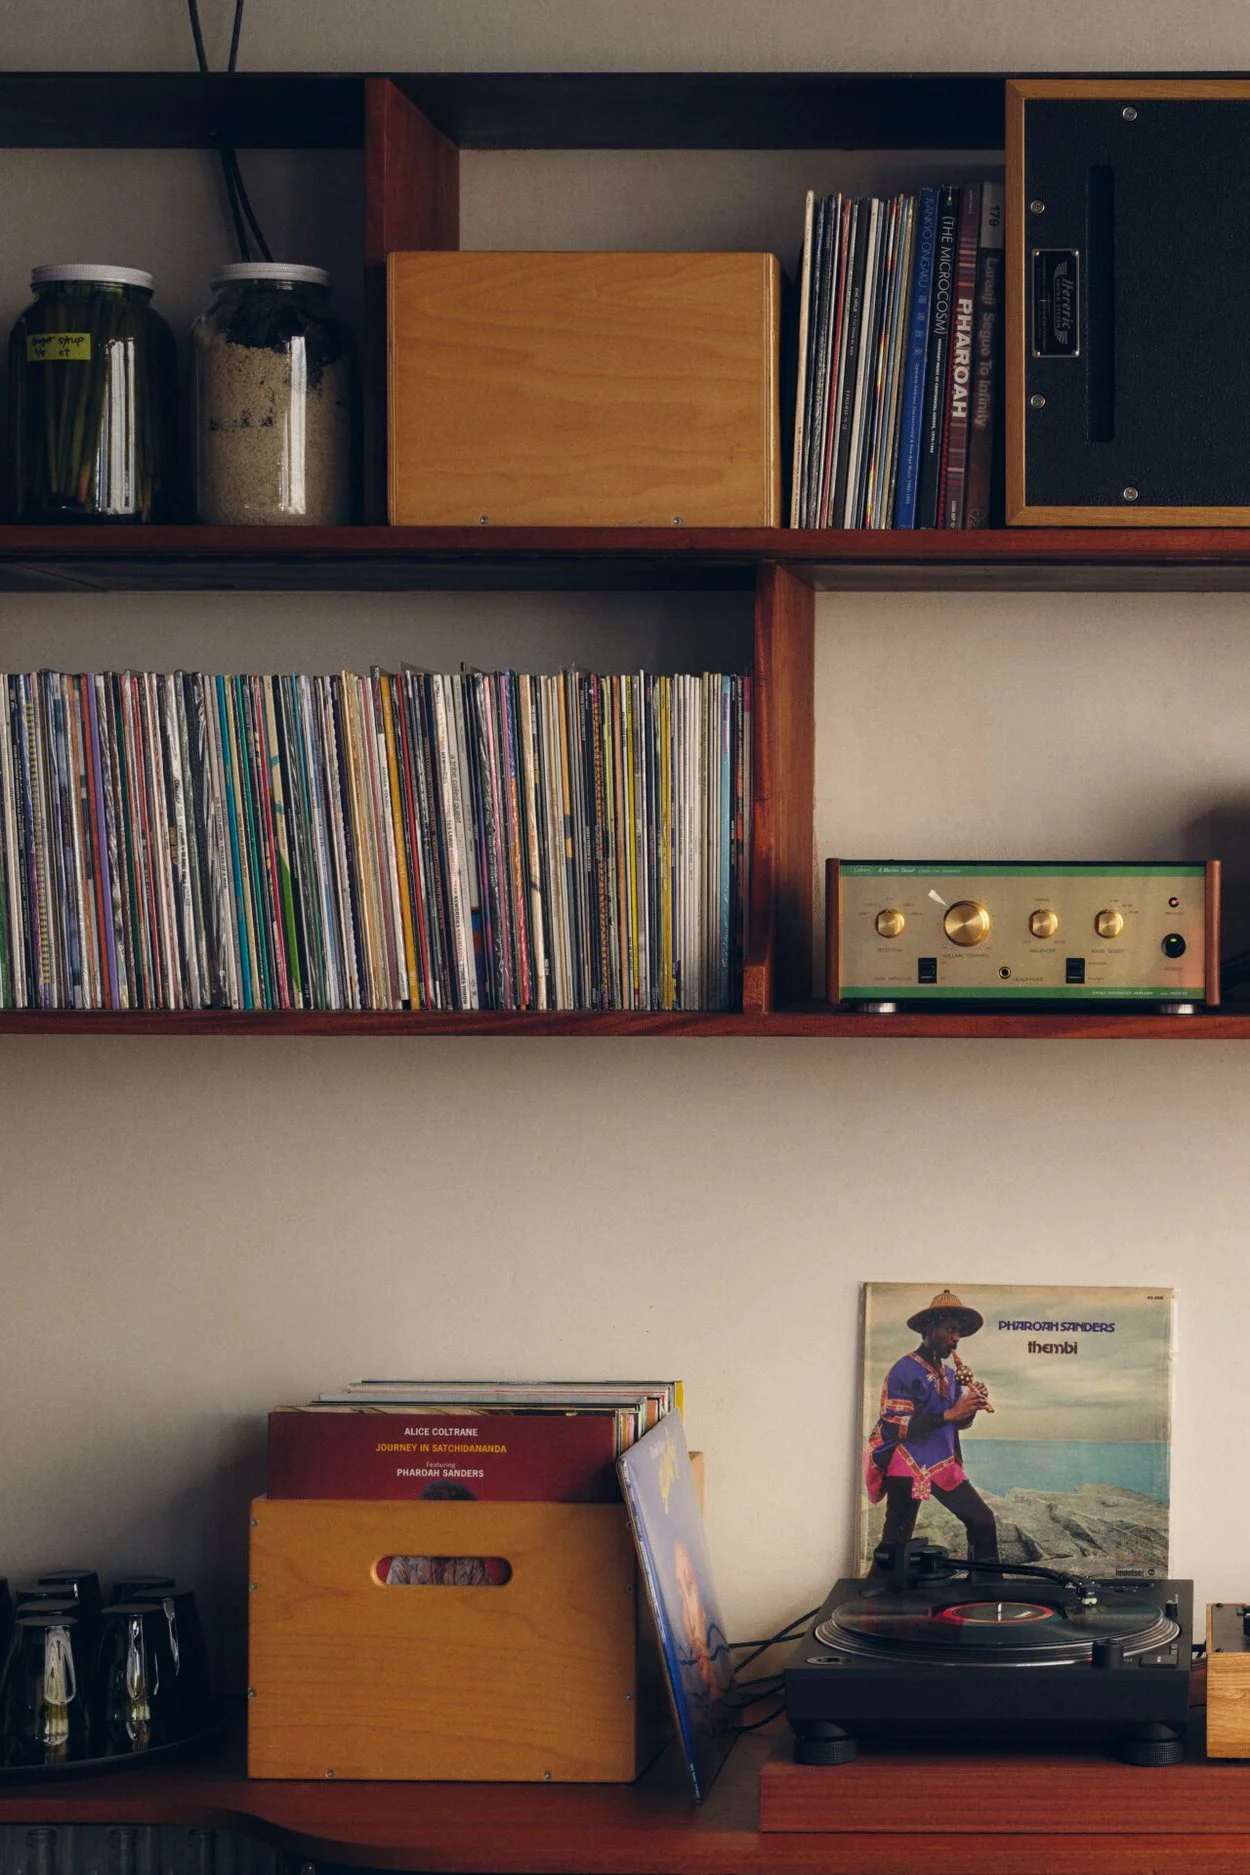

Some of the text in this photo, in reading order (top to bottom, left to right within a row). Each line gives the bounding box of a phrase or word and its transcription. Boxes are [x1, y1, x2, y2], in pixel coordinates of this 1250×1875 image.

[988, 205, 1001, 228] 179
[934, 216, 956, 335] (THE MICROCOSM)
[974, 256, 999, 427] Laraaji Segue To Infinity
[952, 298, 973, 418] PHAROAH
[450, 761, 458, 779] tribe
[452, 780, 460, 802] called
[453, 803, 462, 824] quest
[998, 1320, 1115, 1333] PHAROAH SANDERS
[1027, 1340, 1078, 1355] thembi
[404, 1427, 478, 1436] ALICE COLTRANE
[375, 1443, 507, 1453] JOURNEY IN SATCHIDANANDA
[396, 1468, 484, 1478] PHAROAH SANDERS
[426, 1461, 456, 1469] Featuring
